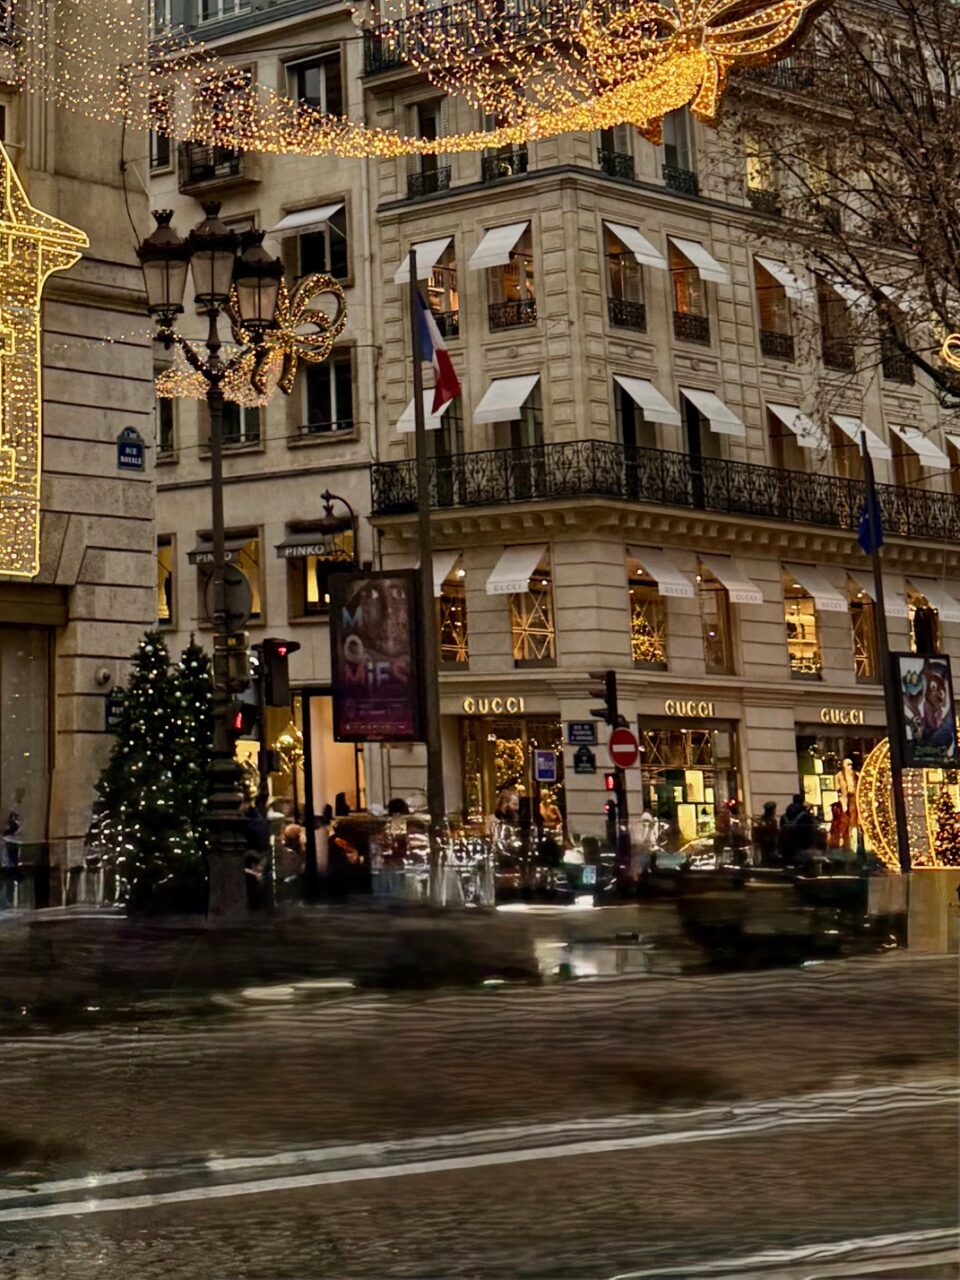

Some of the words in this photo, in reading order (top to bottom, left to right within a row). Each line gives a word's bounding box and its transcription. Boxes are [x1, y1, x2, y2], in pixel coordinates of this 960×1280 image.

[196, 551, 233, 563] PINO
[285, 544, 325, 557] PINKO
[463, 697, 525, 714] GUCCI
[665, 700, 715, 717] GUCCI
[820, 708, 865, 725] GUCCI
